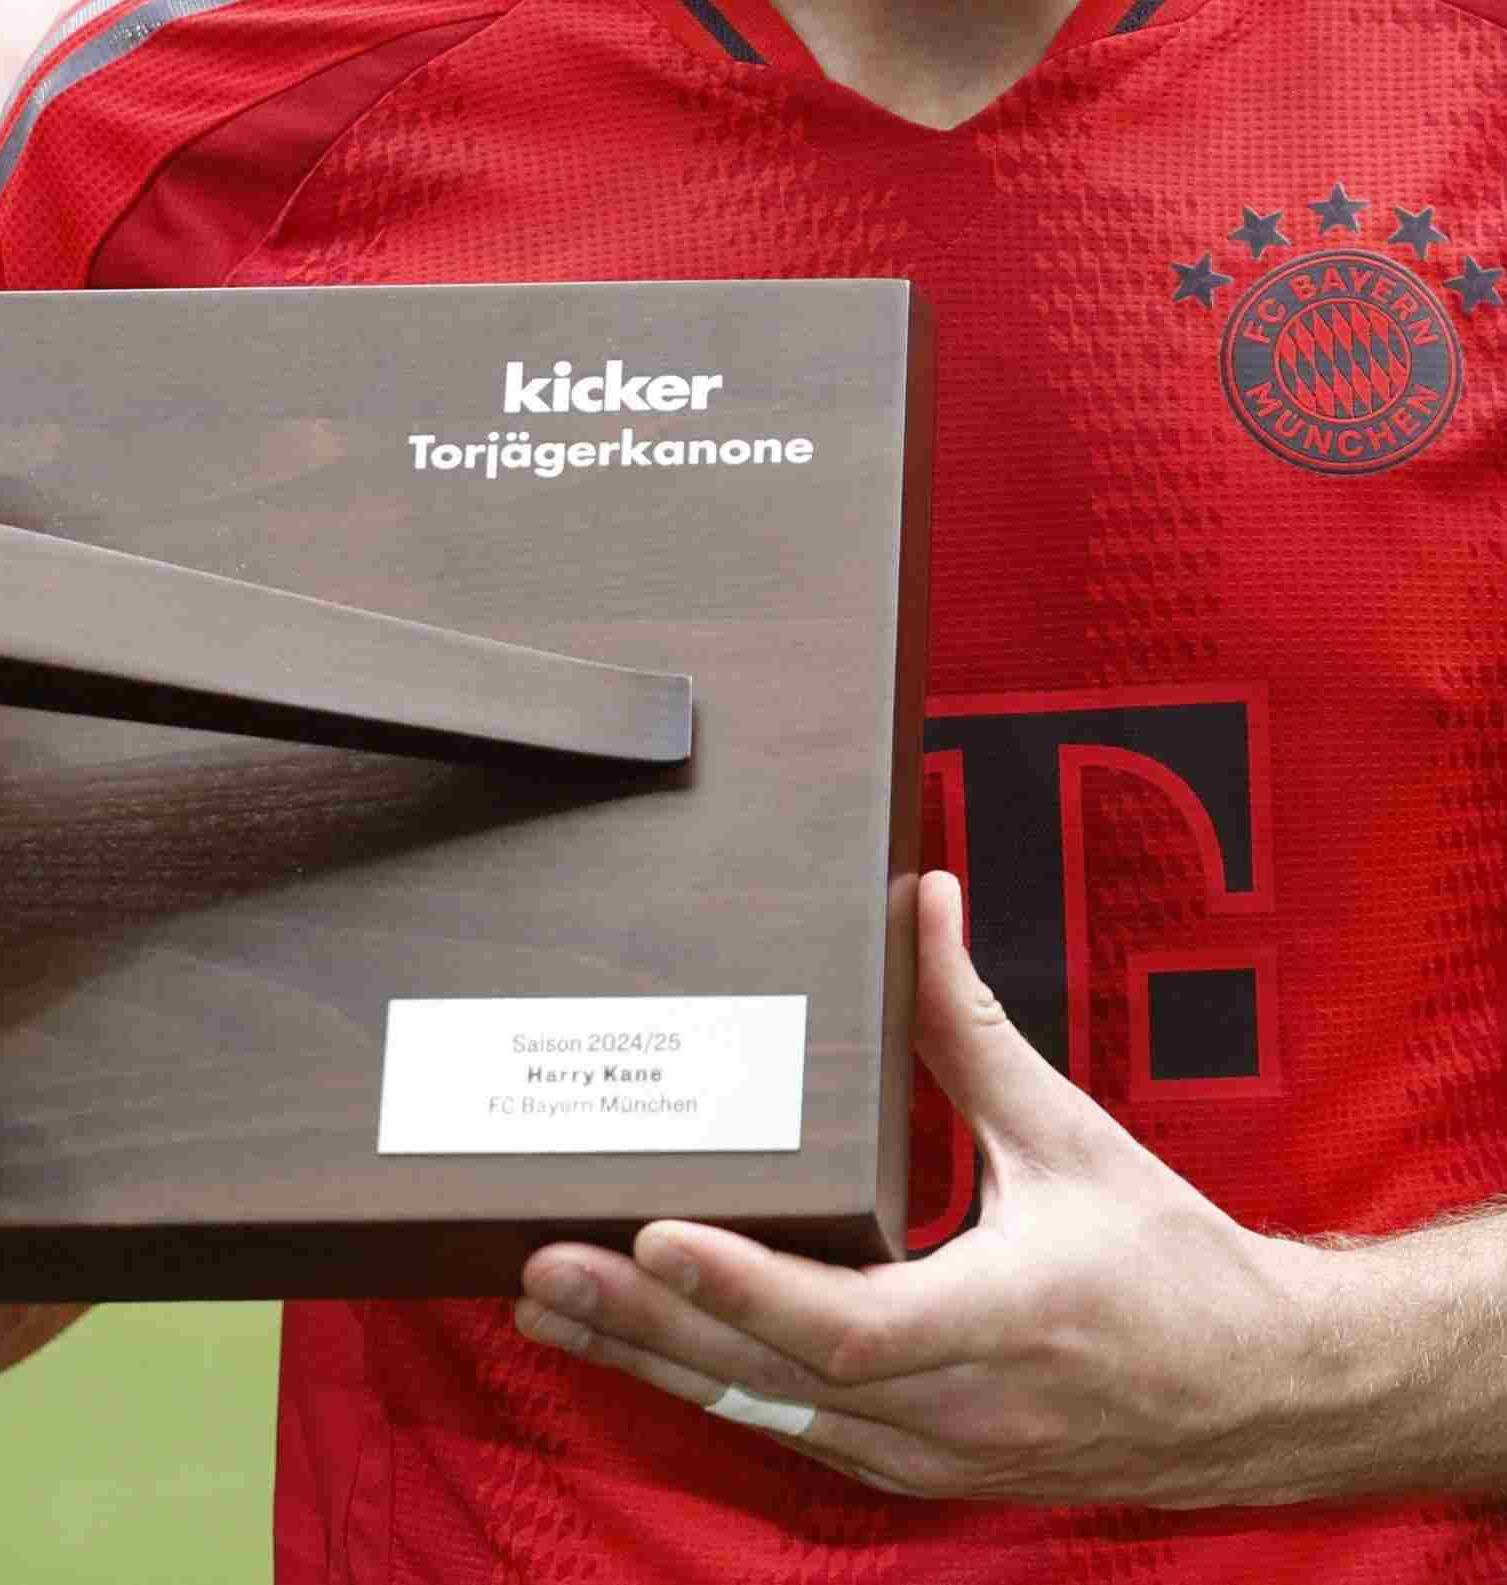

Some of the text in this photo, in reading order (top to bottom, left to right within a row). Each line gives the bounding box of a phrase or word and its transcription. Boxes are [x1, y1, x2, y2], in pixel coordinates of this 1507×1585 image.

[1243, 265, 1439, 347] FC BAYERN
[502, 359, 724, 414] kicker
[408, 427, 814, 479] Torjägerkanone
[511, 1031, 682, 1055] Saison 2024/25
[526, 1064, 664, 1087] Harry Kane
[487, 1094, 699, 1118] FC Bayern München
